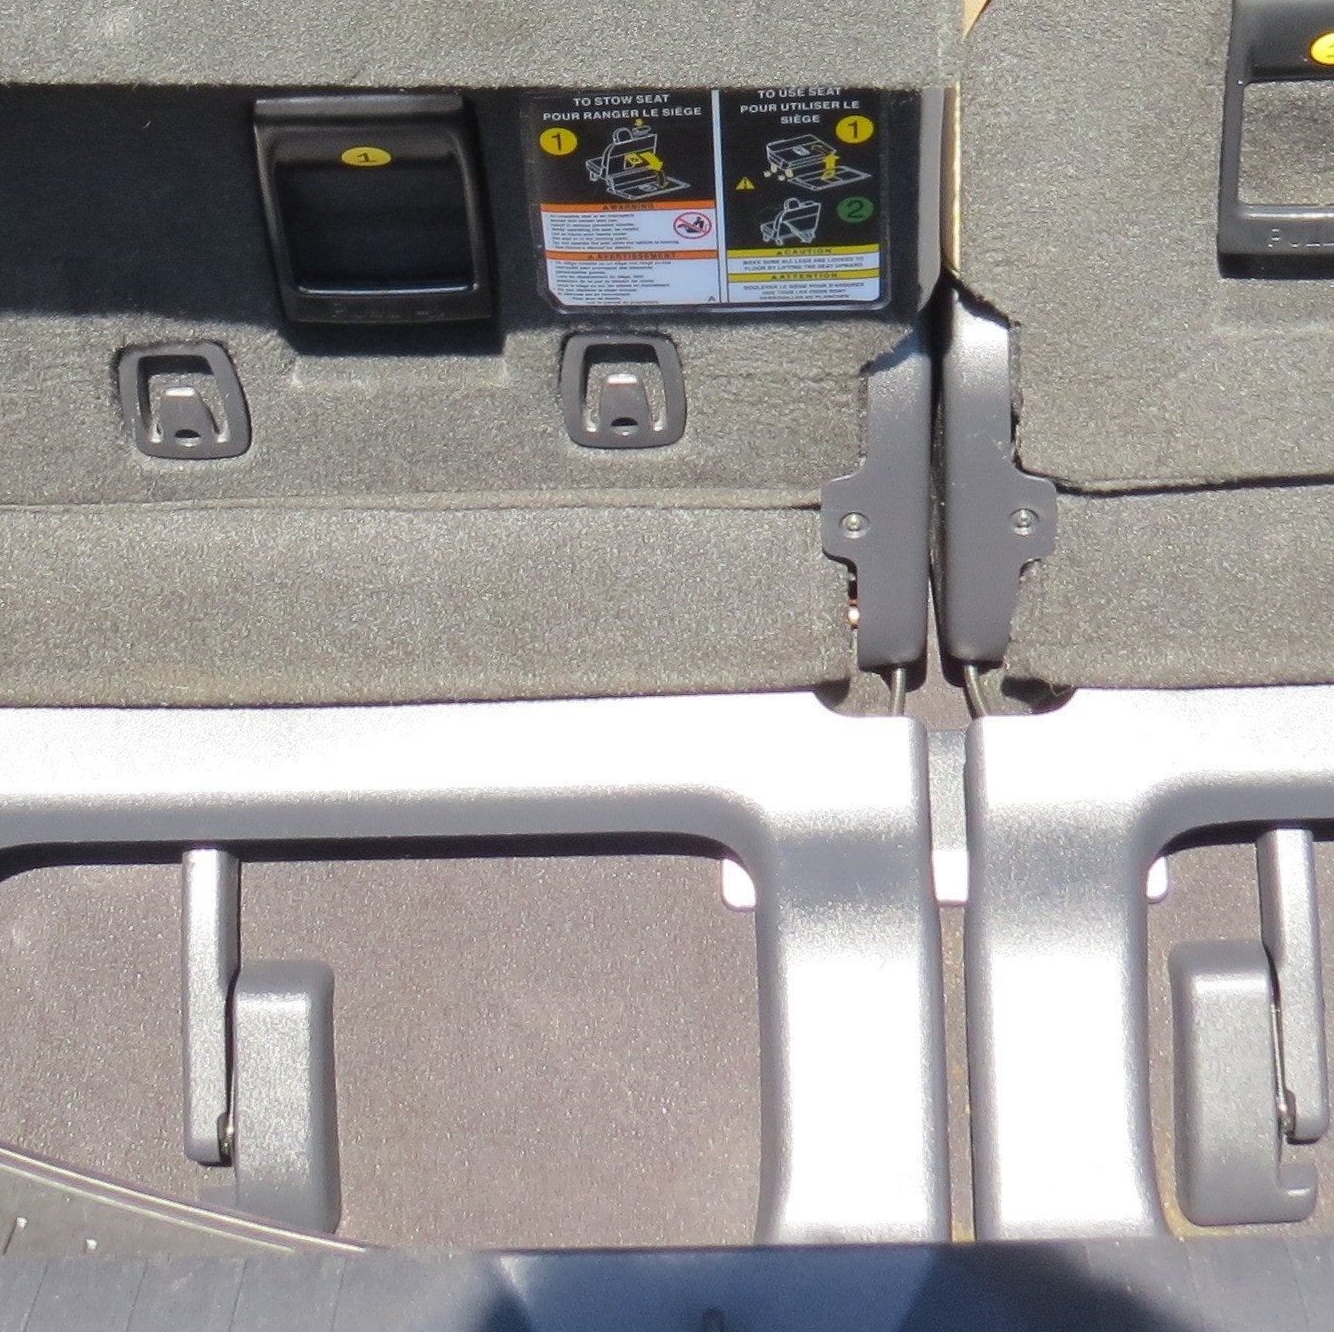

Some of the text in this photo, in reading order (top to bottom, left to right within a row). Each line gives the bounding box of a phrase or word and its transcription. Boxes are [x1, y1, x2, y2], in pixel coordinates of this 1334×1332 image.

[758, 87, 842, 99] TO USE SEAT
[573, 94, 670, 107] TO STOW SEAT
[740, 100, 860, 114] POUR UTILISER LE
[543, 111, 581, 121] POUR
[583, 109, 639, 120] RANGER
[642, 108, 659, 117] LE
[611, 202, 655, 210] WARNING
[847, 200, 864, 219] 2
